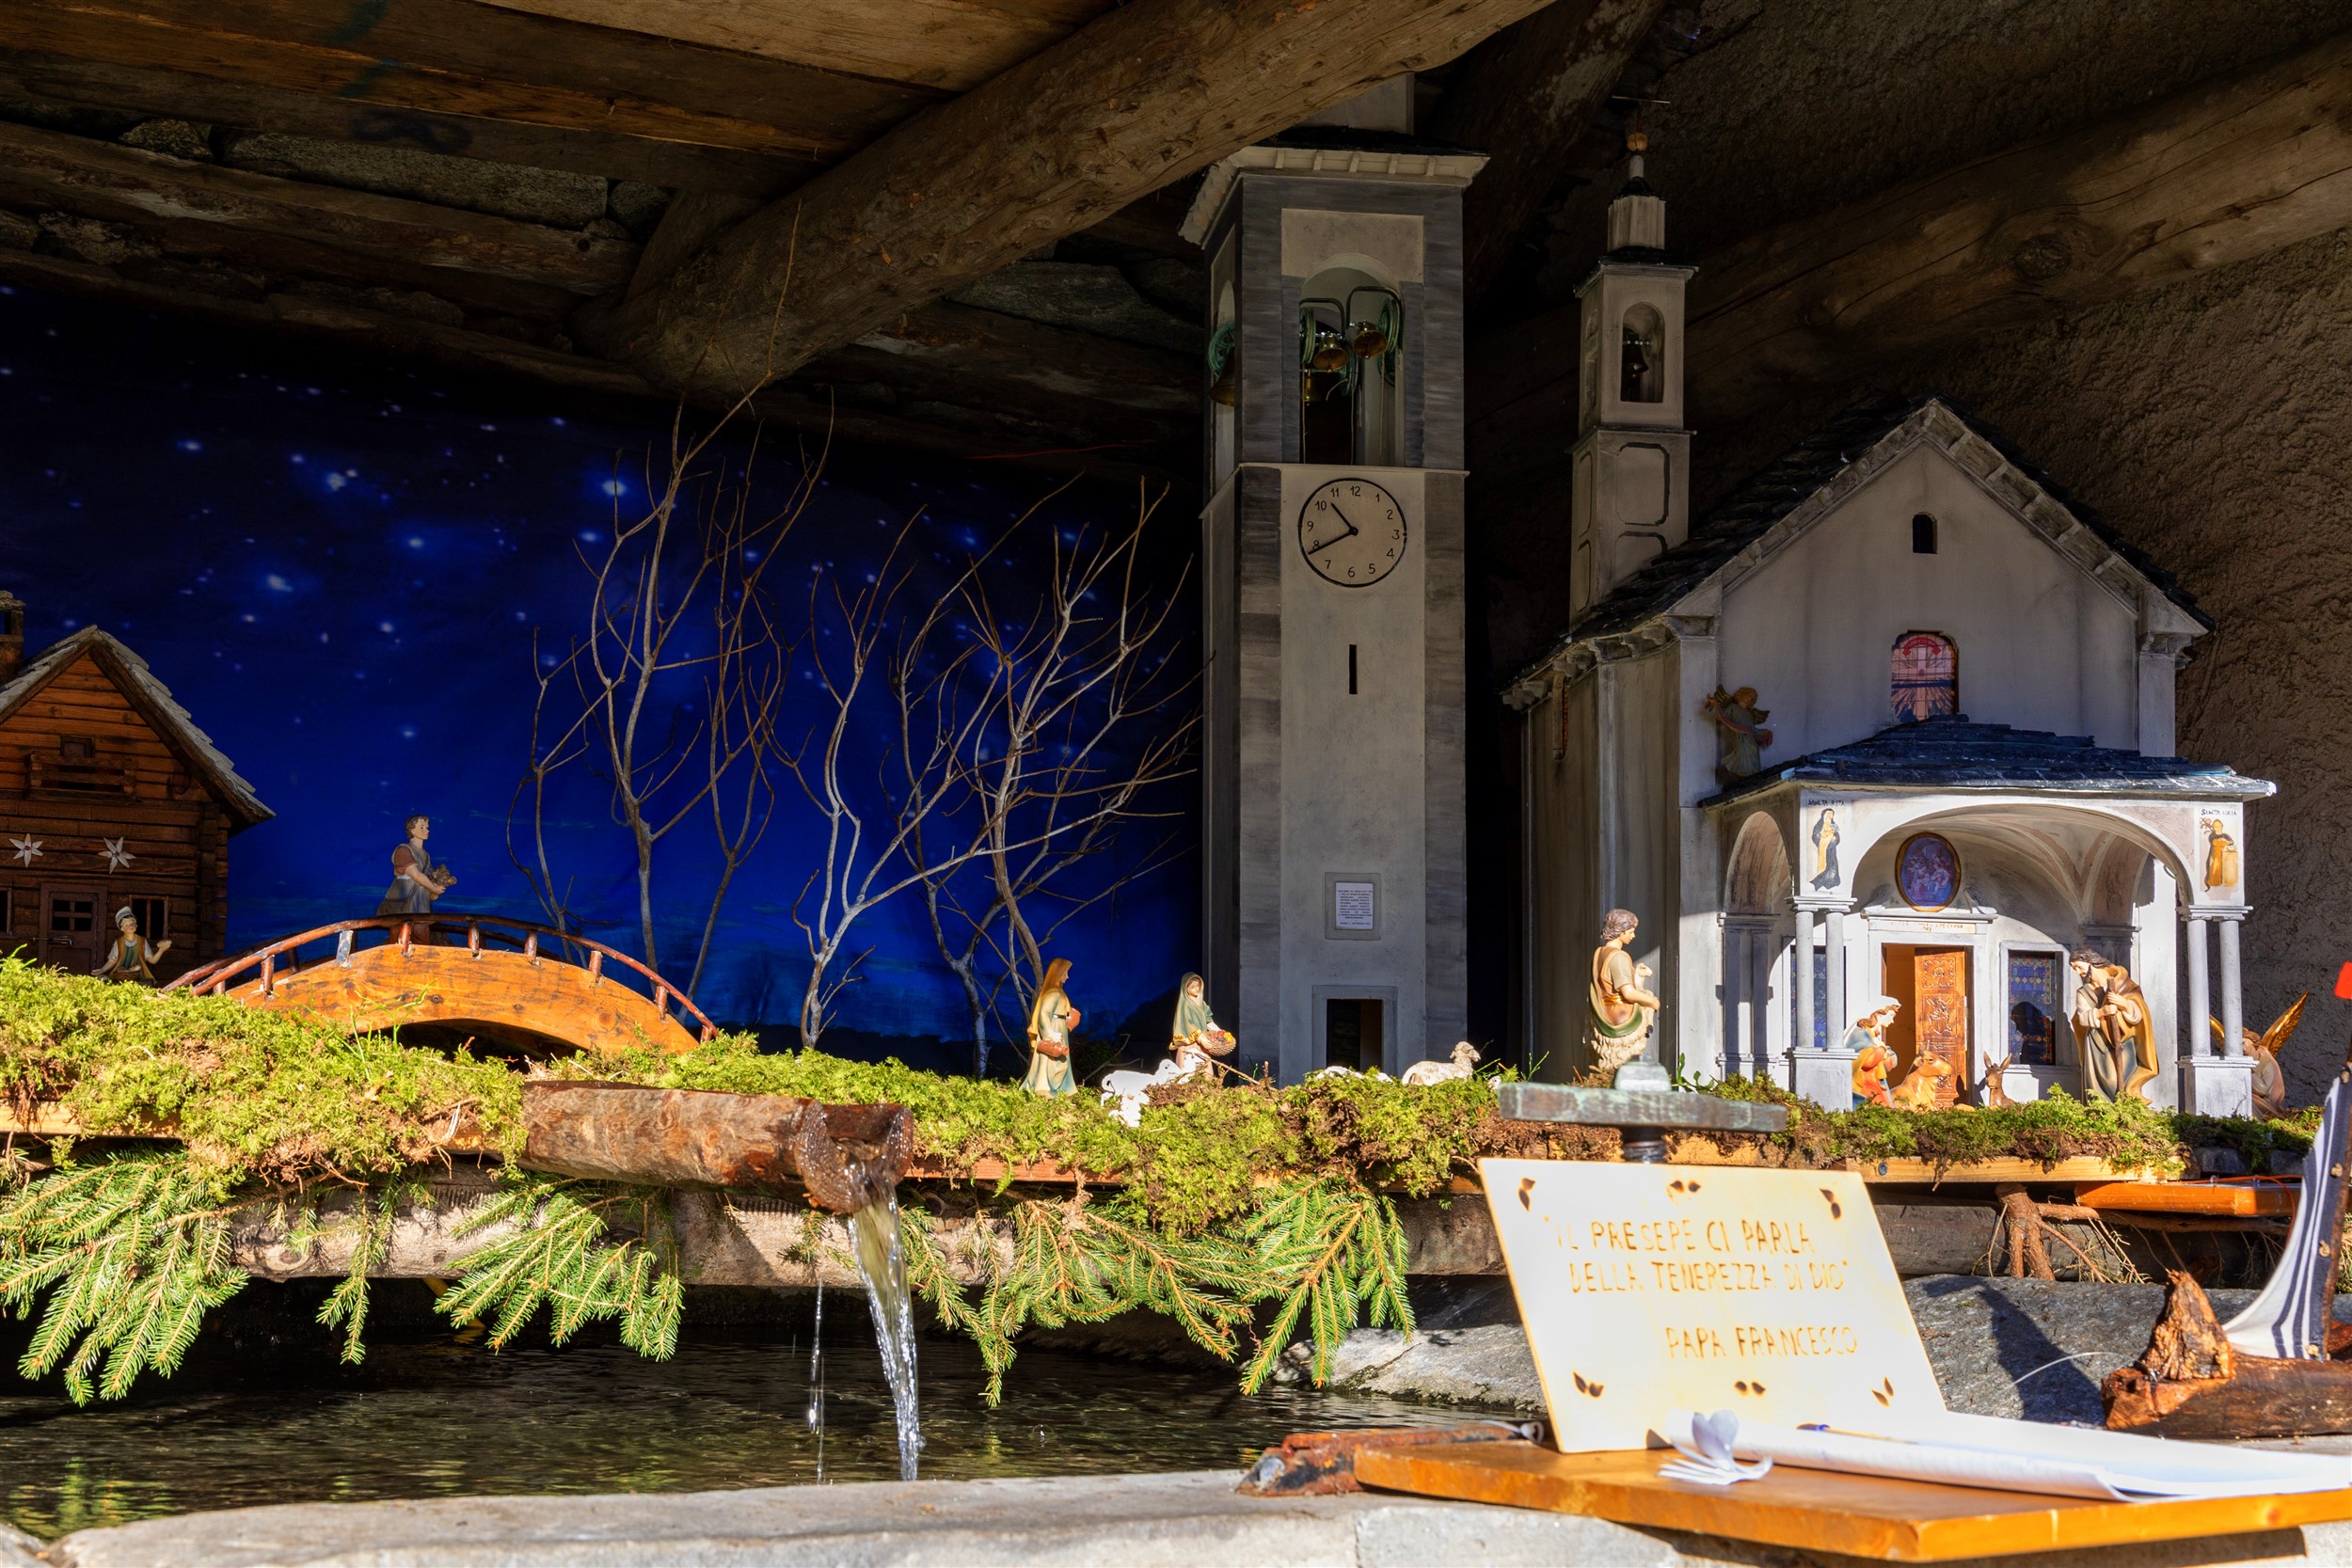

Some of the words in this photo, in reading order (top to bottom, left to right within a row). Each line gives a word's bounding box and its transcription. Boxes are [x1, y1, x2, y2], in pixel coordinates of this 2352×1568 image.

[1330, 487, 1340, 498] 11
[1349, 485, 1361, 497] 12
[1375, 493, 1380, 502] 1
[1314, 500, 1327, 511] 10
[1386, 509, 1393, 520] 2
[1307, 520, 1314, 532] 9
[1391, 529, 1400, 540] 3
[1311, 540, 1322, 551] 8
[1386, 547, 1395, 560] 4
[1325, 560, 1331, 569] 7
[1368, 562, 1376, 575] 5
[1347, 566, 1356, 578] 6
[1591, 1220, 1696, 1252] PRESEPE
[1707, 1221, 1731, 1253] CI
[1741, 1219, 1816, 1255] PARLA
[1568, 1262, 1644, 1293] DELLA
[1651, 1261, 1776, 1292] TENEREZZA
[1784, 1263, 1804, 1291] DI
[1665, 1326, 1727, 1359] PAPA
[1735, 1326, 1858, 1357] FRANCESCO
